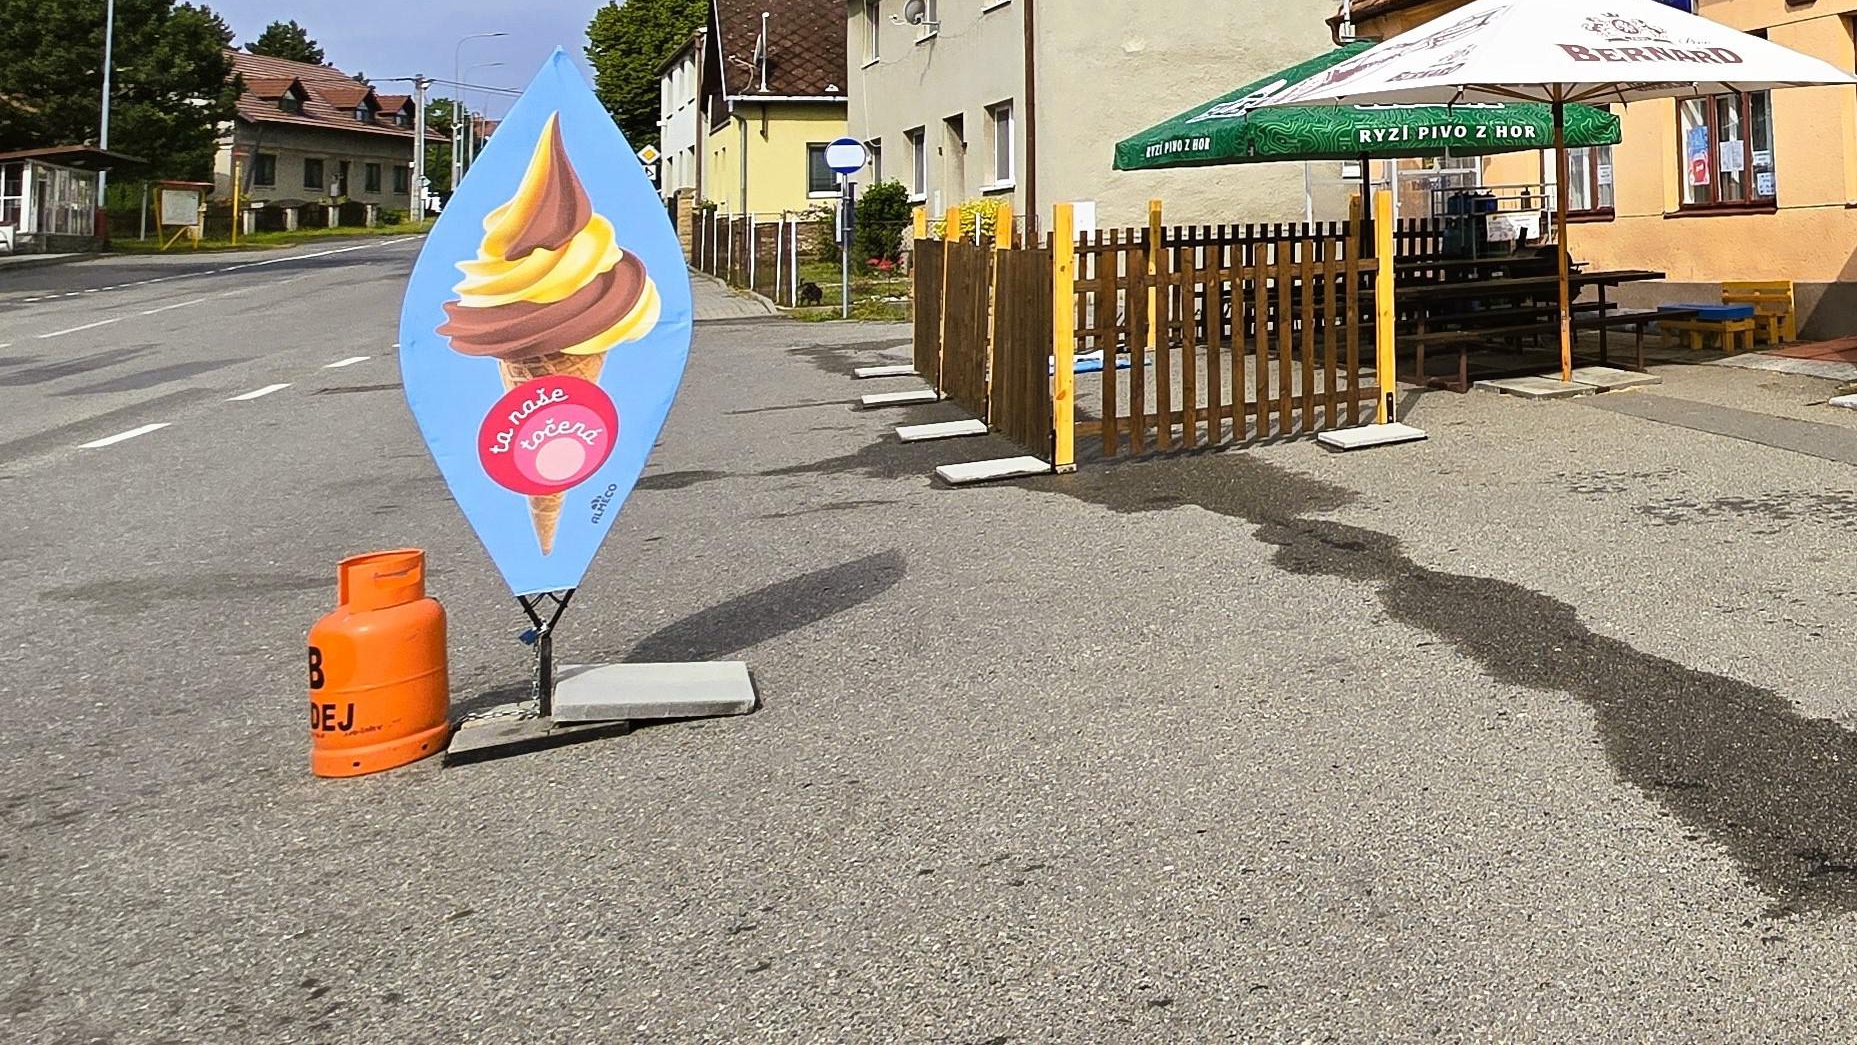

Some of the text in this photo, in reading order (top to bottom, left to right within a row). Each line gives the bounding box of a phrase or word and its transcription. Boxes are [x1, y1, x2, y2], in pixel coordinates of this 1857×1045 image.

[1553, 43, 1744, 64] BERNARD
[1164, 138, 1183, 154] PIVO
[1184, 139, 1190, 151] Z
[1192, 137, 1210, 151] HOR
[1359, 124, 1536, 143] RYZÍ PIVO Z HOR
[489, 388, 569, 454] ta naše
[520, 418, 603, 451] točená
[591, 483, 617, 524] ALMECO
